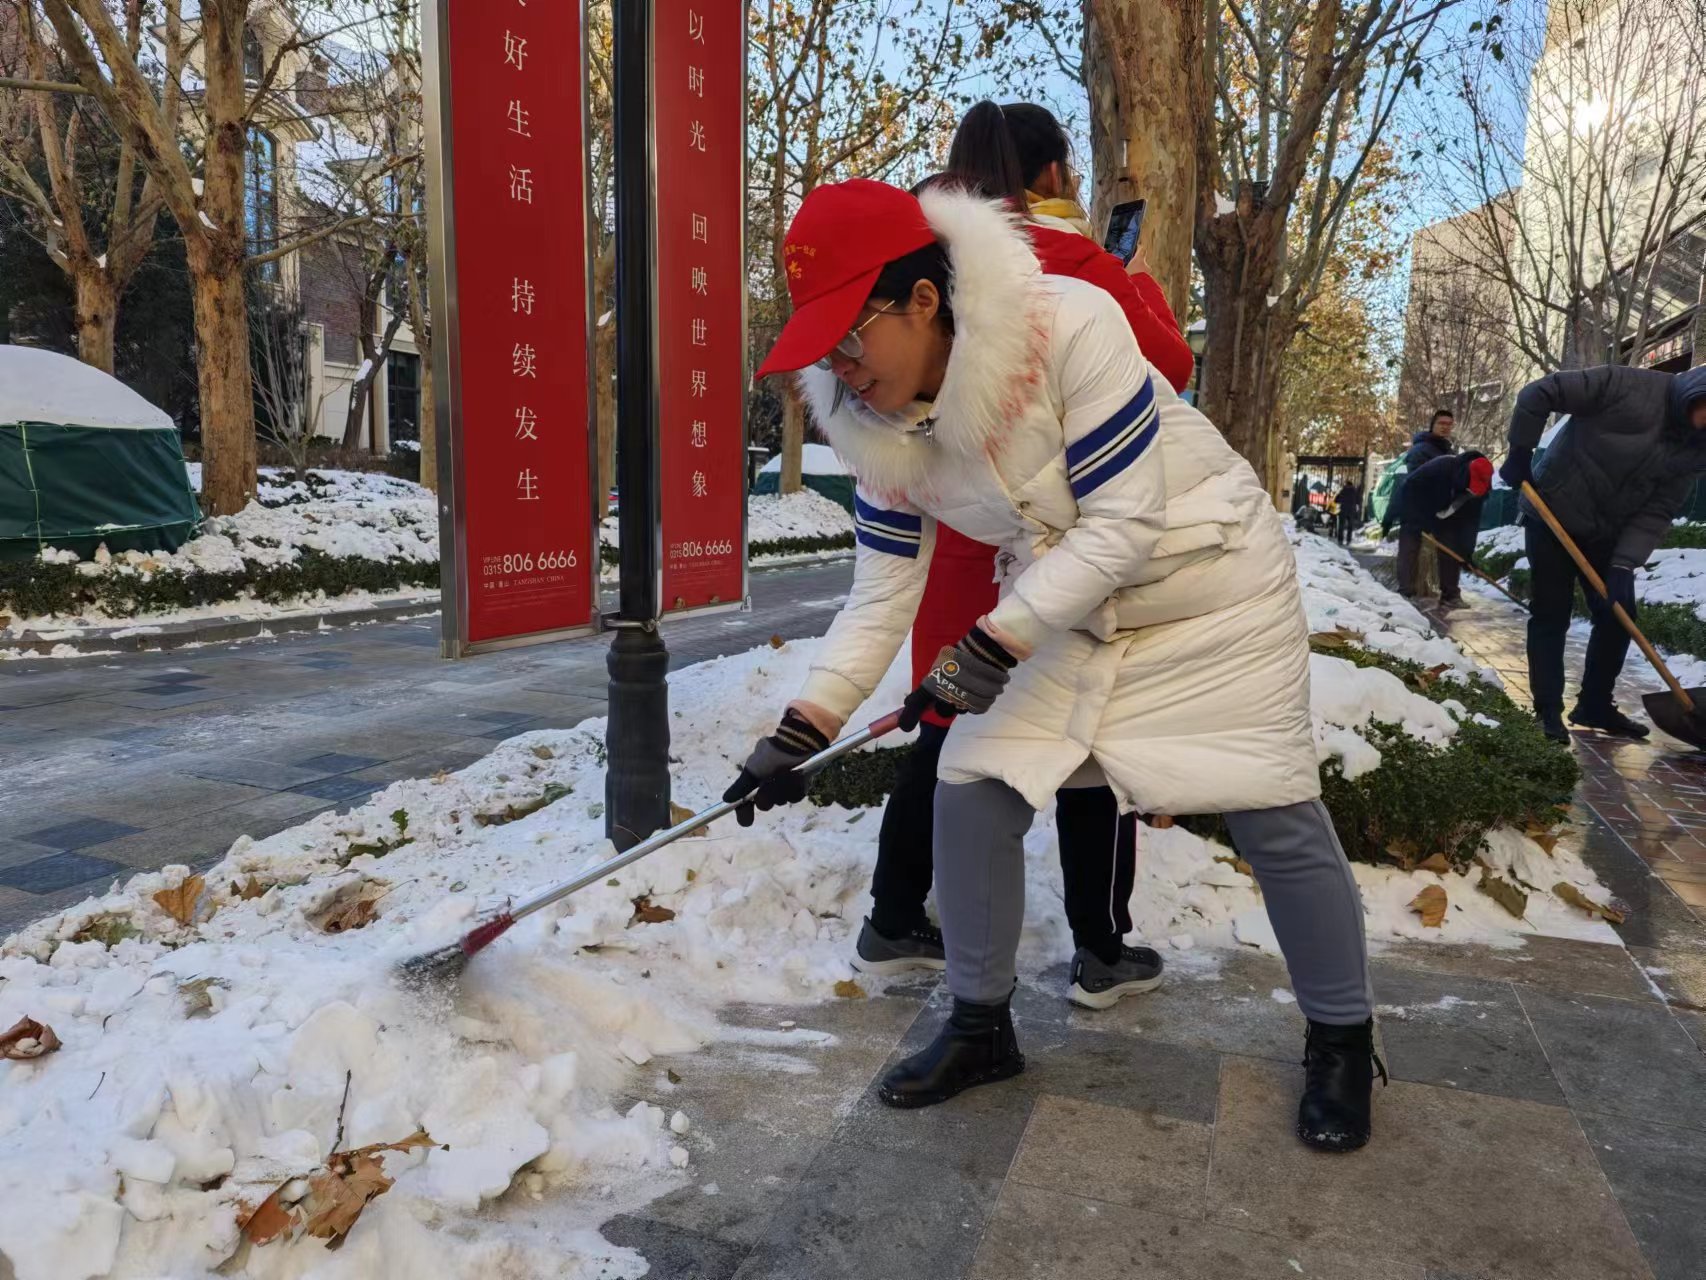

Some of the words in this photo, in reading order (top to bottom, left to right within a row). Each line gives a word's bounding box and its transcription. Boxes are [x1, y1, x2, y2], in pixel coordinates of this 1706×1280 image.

[503, 0, 534, 204] 好生活
[688, 8, 706, 153] 以时光
[512, 277, 540, 501] 持续发生
[691, 212, 708, 498] 回映世界想象
[483, 564, 502, 576] 0315
[503, 552, 534, 574] 806
[537, 549, 577, 570] 6666
[546, 575, 565, 583] CHINA
[682, 541, 703, 557] 806
[705, 539, 732, 555] 6666
[928, 668, 967, 699] APPLE
